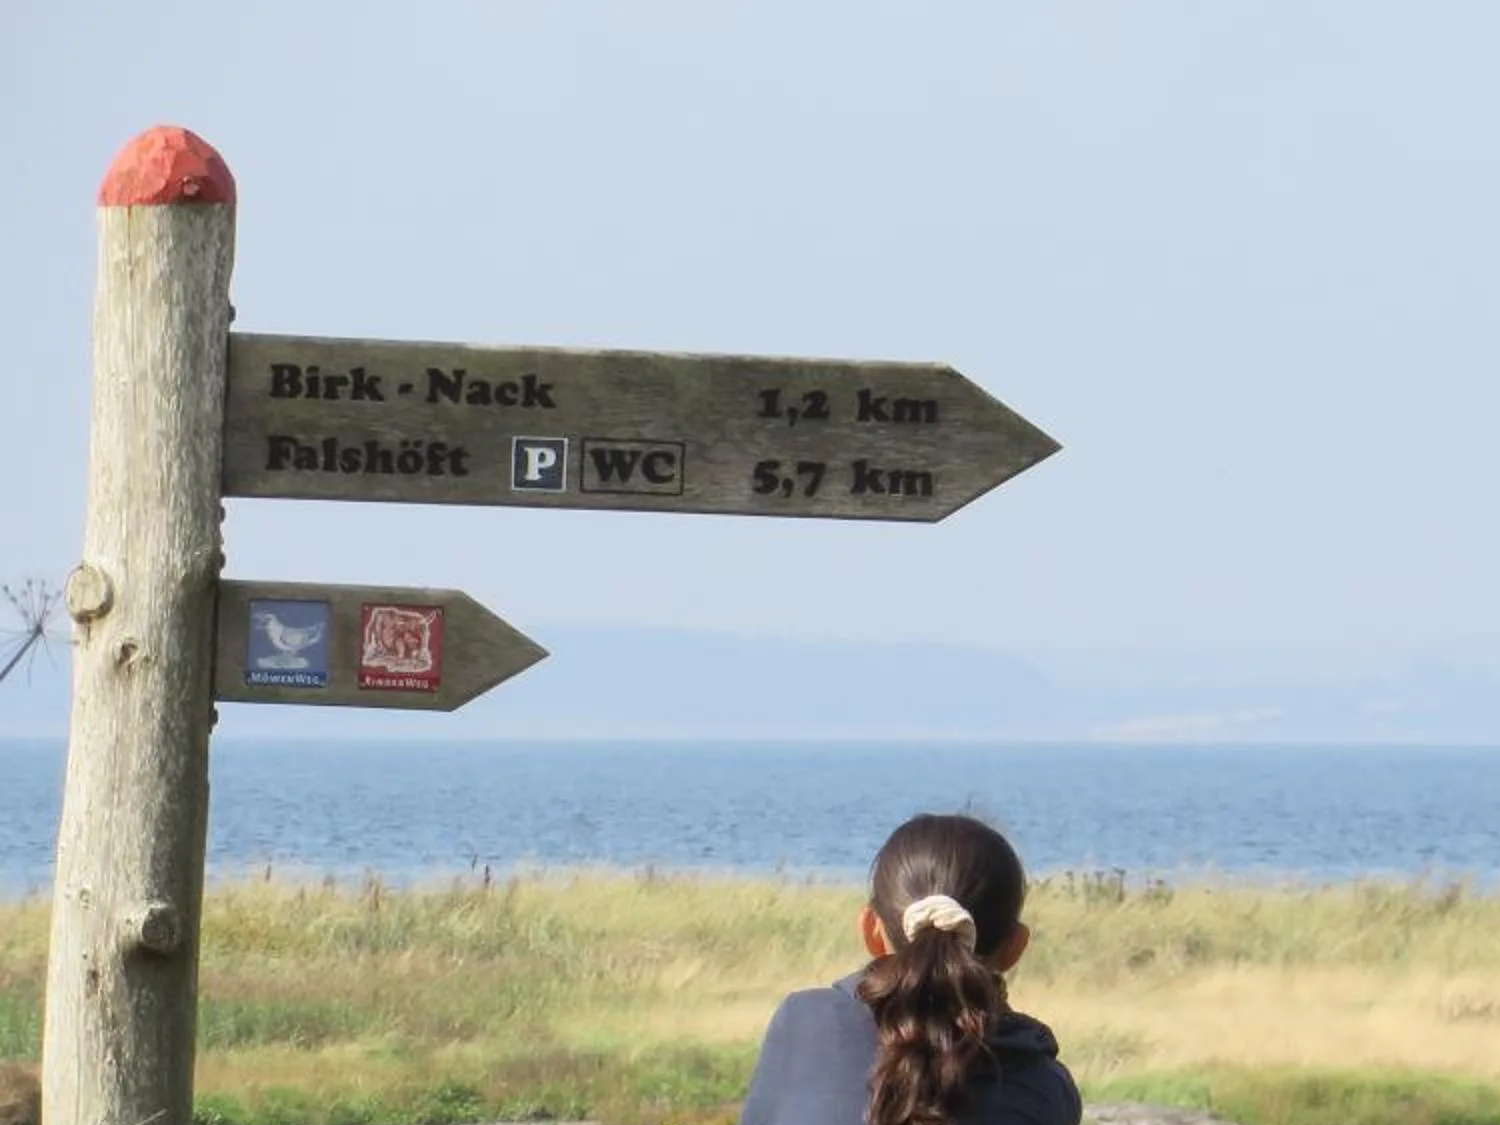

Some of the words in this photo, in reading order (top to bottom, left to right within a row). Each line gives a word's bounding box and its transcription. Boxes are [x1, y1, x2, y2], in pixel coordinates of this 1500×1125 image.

[269, 363, 385, 402] Birk
[426, 367, 557, 408] Nack
[756, 388, 831, 427] 1,2
[857, 389, 938, 424] km
[266, 435, 470, 477] Falshöft
[523, 446, 557, 481] P
[588, 448, 676, 485] WC
[752, 460, 827, 498] 5,7
[850, 460, 934, 497] km
